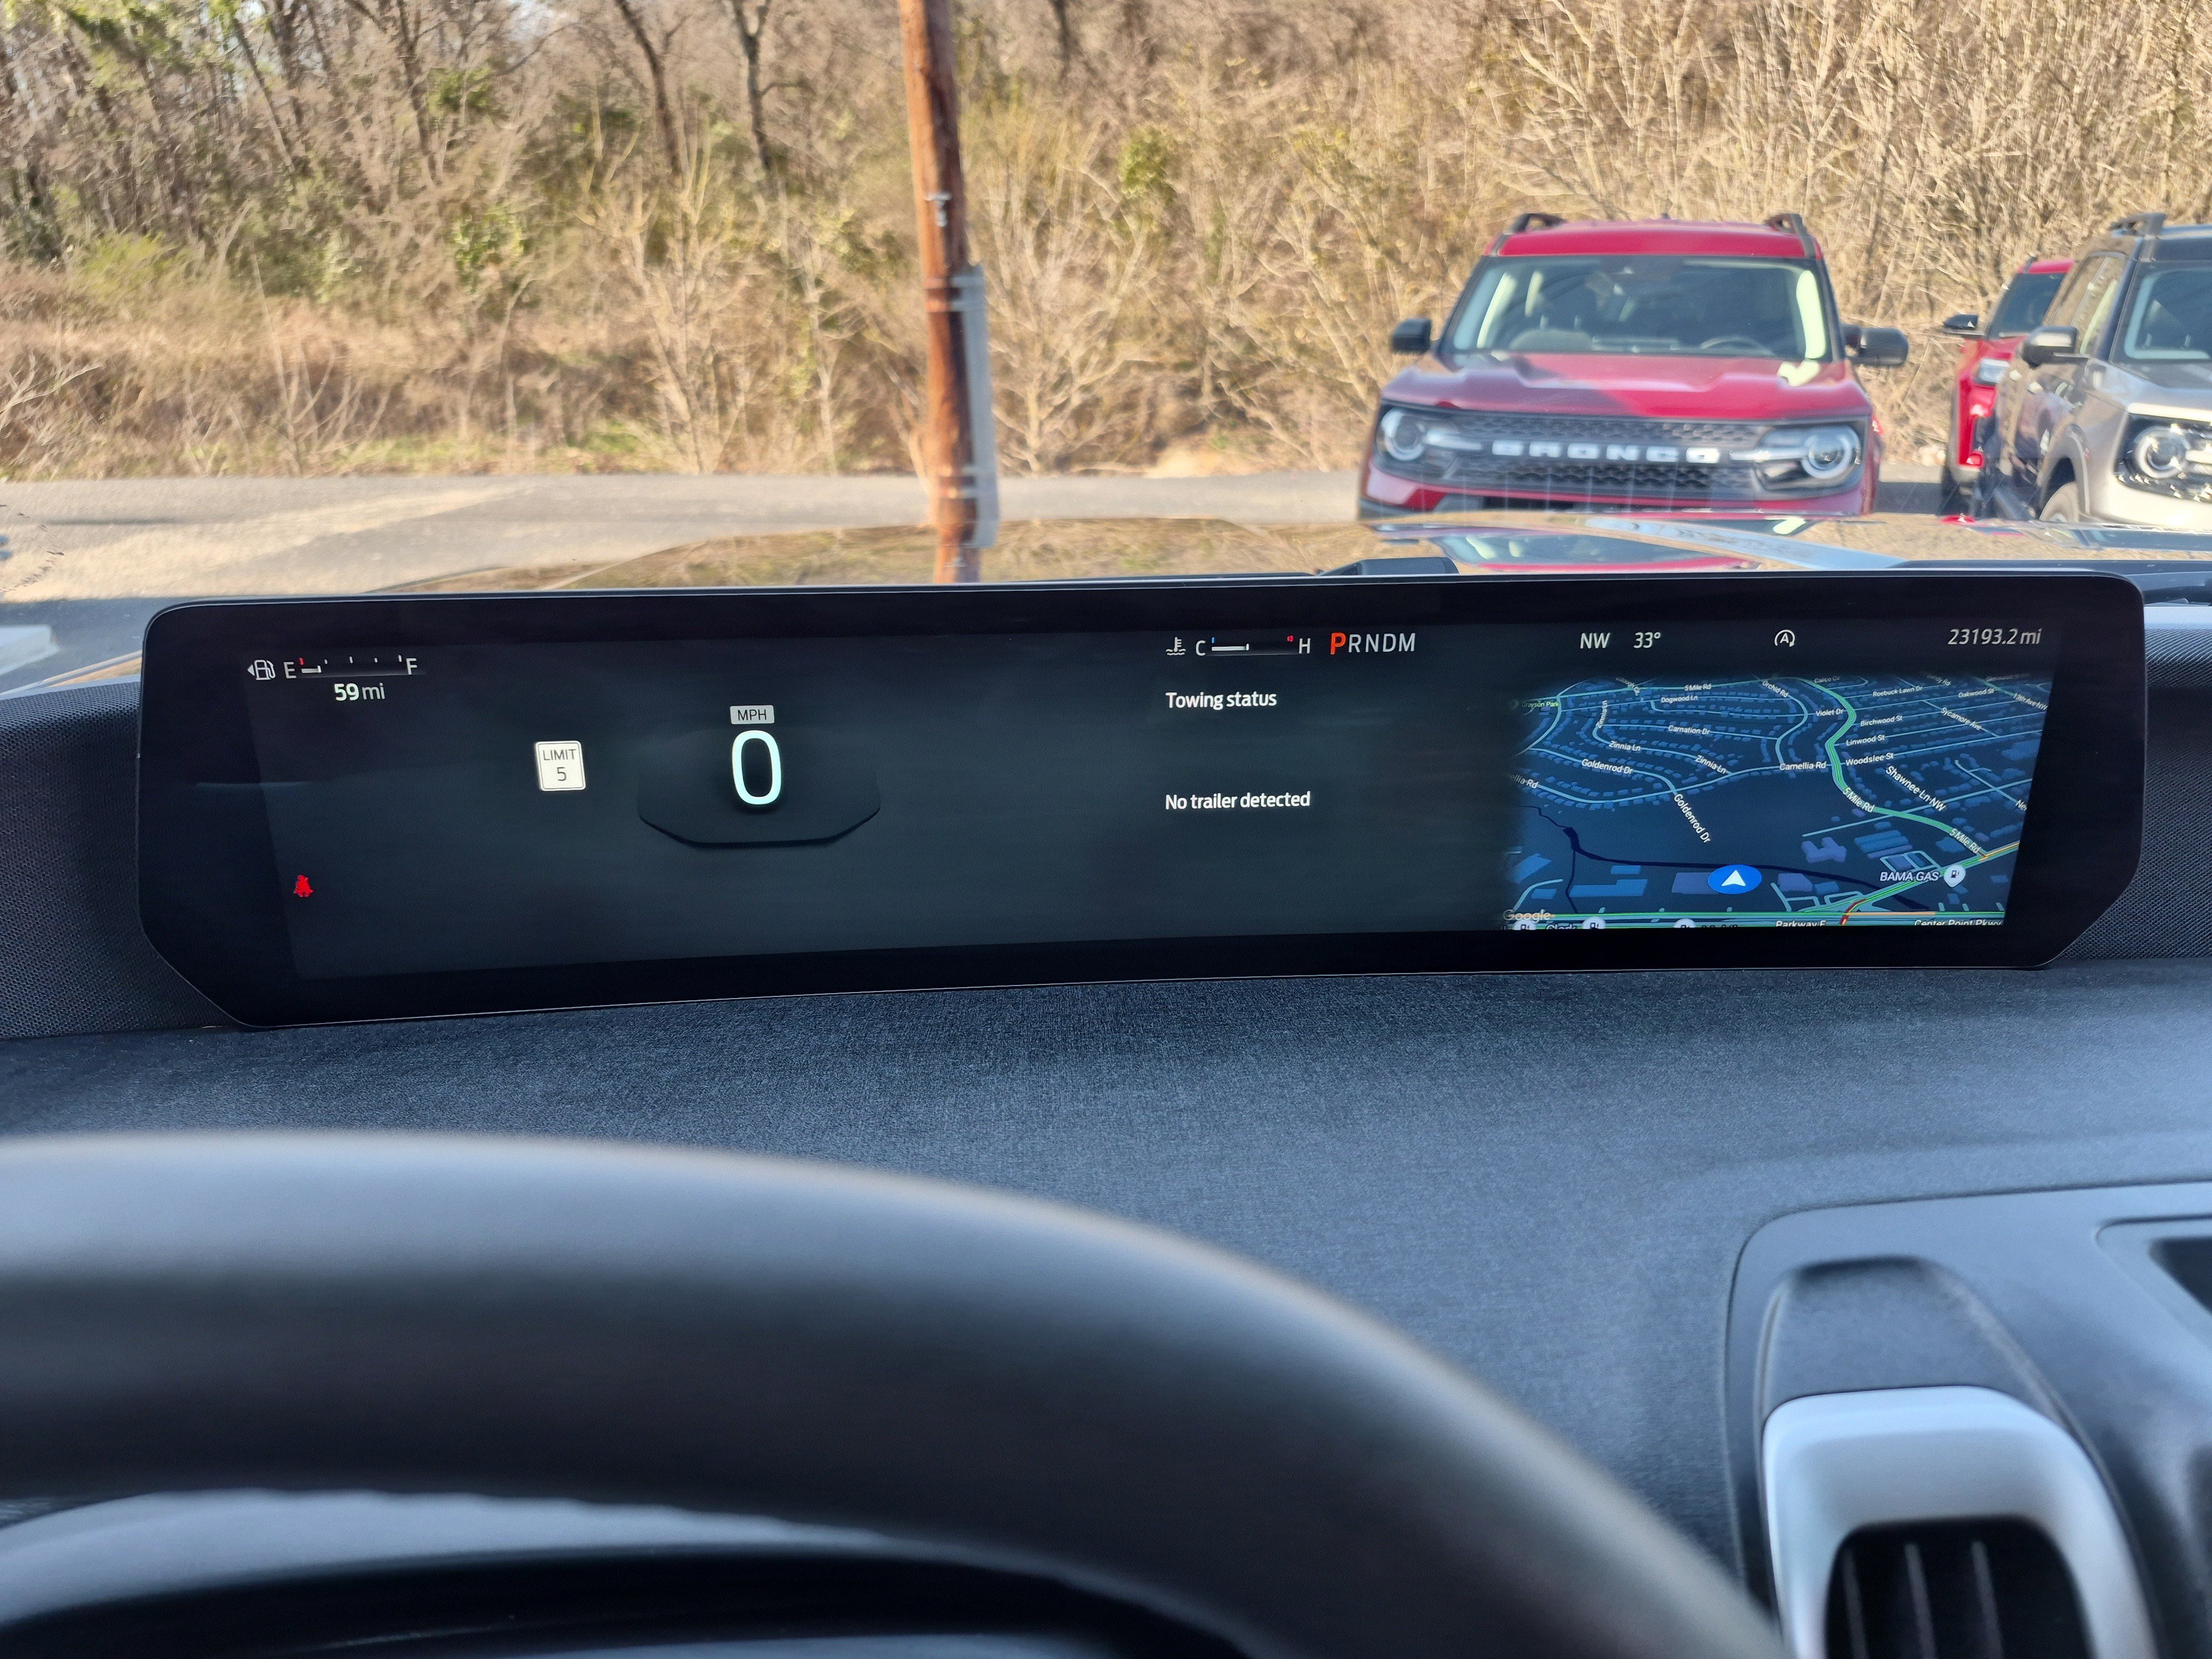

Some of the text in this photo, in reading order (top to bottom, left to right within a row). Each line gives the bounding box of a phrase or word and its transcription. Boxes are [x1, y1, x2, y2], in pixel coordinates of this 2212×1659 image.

[1491, 440, 1721, 464] BRONCO
[1579, 632, 1611, 649] NW
[1947, 627, 2042, 645] 23193.2 mi
[1195, 640, 1207, 656] C
[1298, 638, 1311, 654] H
[283, 661, 297, 679] E
[406, 658, 418, 675] F
[333, 682, 386, 701] 59 mi
[1762, 680, 1789, 698] Orchid Rd
[1958, 689, 1987, 698] Oakwood
[1166, 691, 1277, 710] Towing status
[1661, 696, 1689, 704] Dogwood
[737, 709, 767, 722] MPH
[1596, 708, 1607, 729] Zinnia
[1860, 716, 1895, 727] Birchwood
[1941, 706, 1982, 731] Sycamore Ave
[1668, 725, 1701, 734] Carnation
[1609, 740, 1642, 752] Zinnia Ln
[1846, 736, 1876, 747] Linwood
[543, 748, 576, 761] LIMIT
[1845, 755, 1885, 766] Woodslee
[731, 729, 782, 806] 0
[1581, 758, 1634, 775] Goldenrod Dr
[1695, 755, 1727, 774] Zinnia Ln
[1779, 761, 1827, 771] Camellia Rd
[556, 767, 568, 782] 5
[1526, 779, 1539, 789] Rd
[1885, 766, 1947, 812] Shawnee Ln NW
[1165, 790, 1311, 810] No trailer detected
[1846, 790, 1863, 808] Mile
[1862, 802, 1876, 813] Rd
[1674, 793, 1712, 844] Goldenrod Dr
[1953, 831, 1970, 848] Mile
[1968, 841, 1981, 854] Rd
[1879, 871, 1940, 882] BAMA GAS
[1502, 908, 1552, 923] Google
